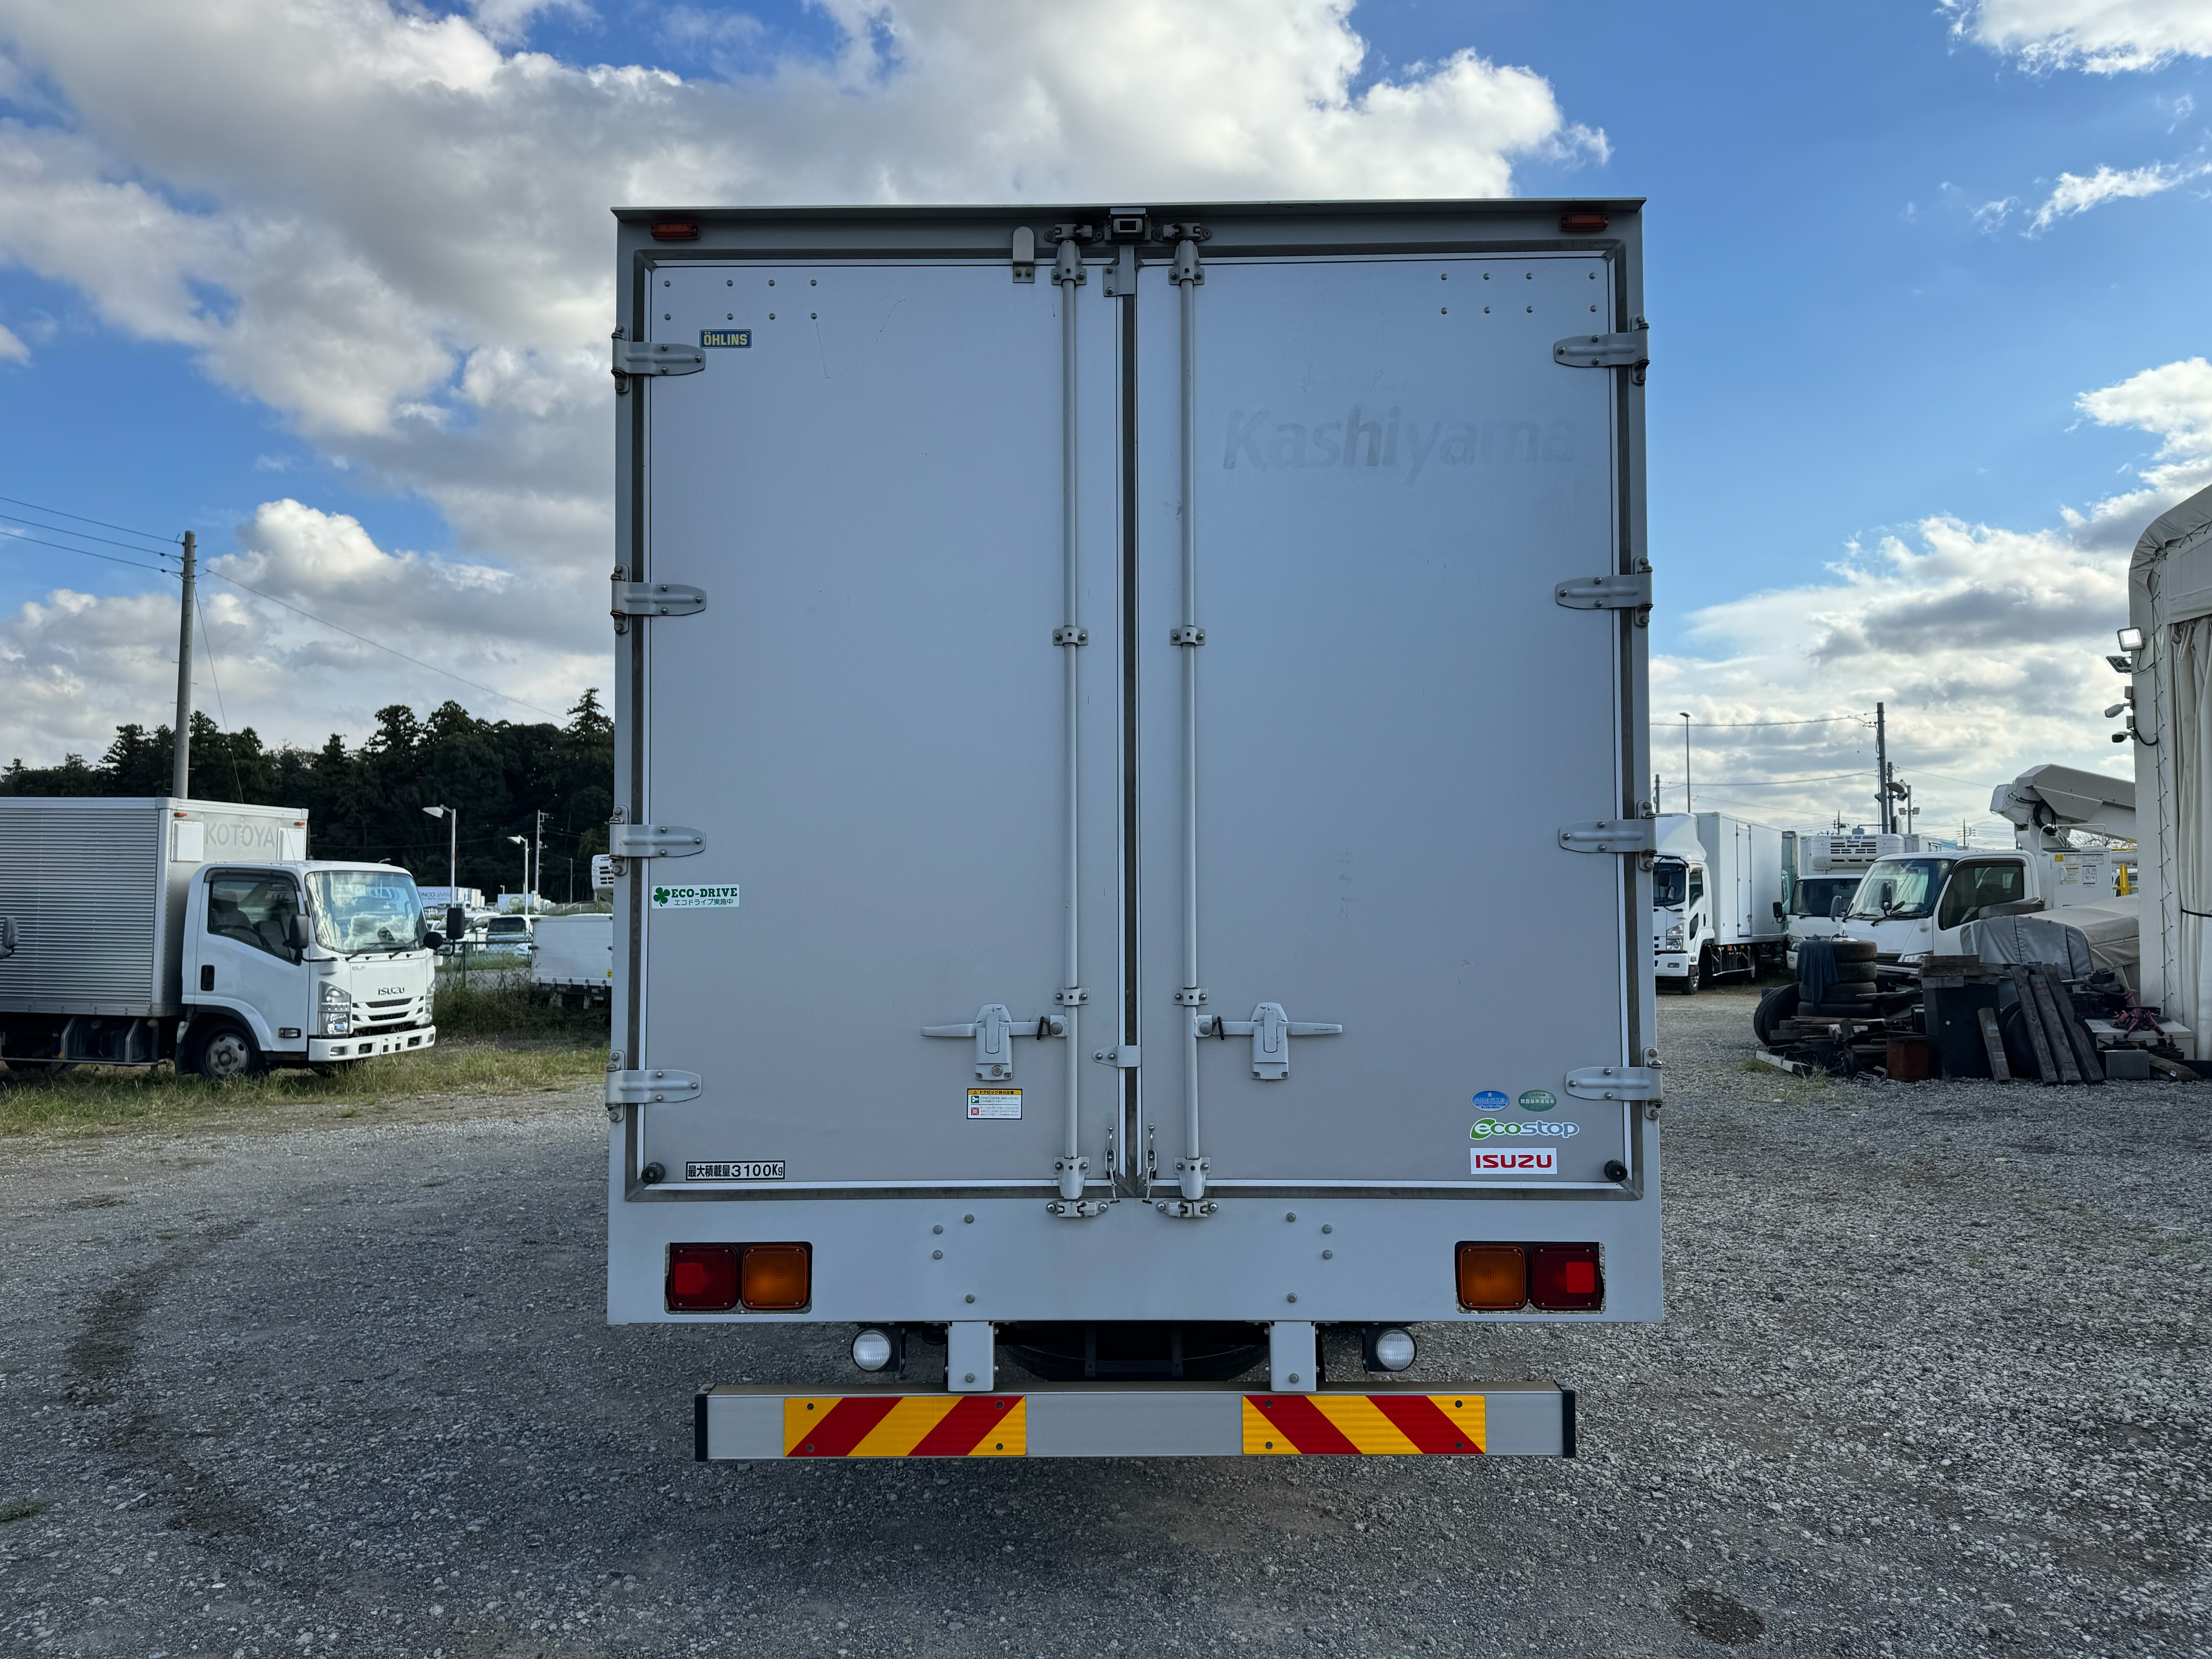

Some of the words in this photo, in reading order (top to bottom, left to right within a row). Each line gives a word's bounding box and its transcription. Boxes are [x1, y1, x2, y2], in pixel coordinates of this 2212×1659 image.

[704, 331, 748, 346] ÖHLINS
[1222, 403, 1578, 486] Kashiyama
[205, 822, 275, 848] KOTOYA
[671, 888, 737, 898] ECO-DRIVE
[378, 987, 405, 995] ISUZU
[1474, 1120, 1579, 1137] ecostop
[1475, 1154, 1552, 1168] ISUZU
